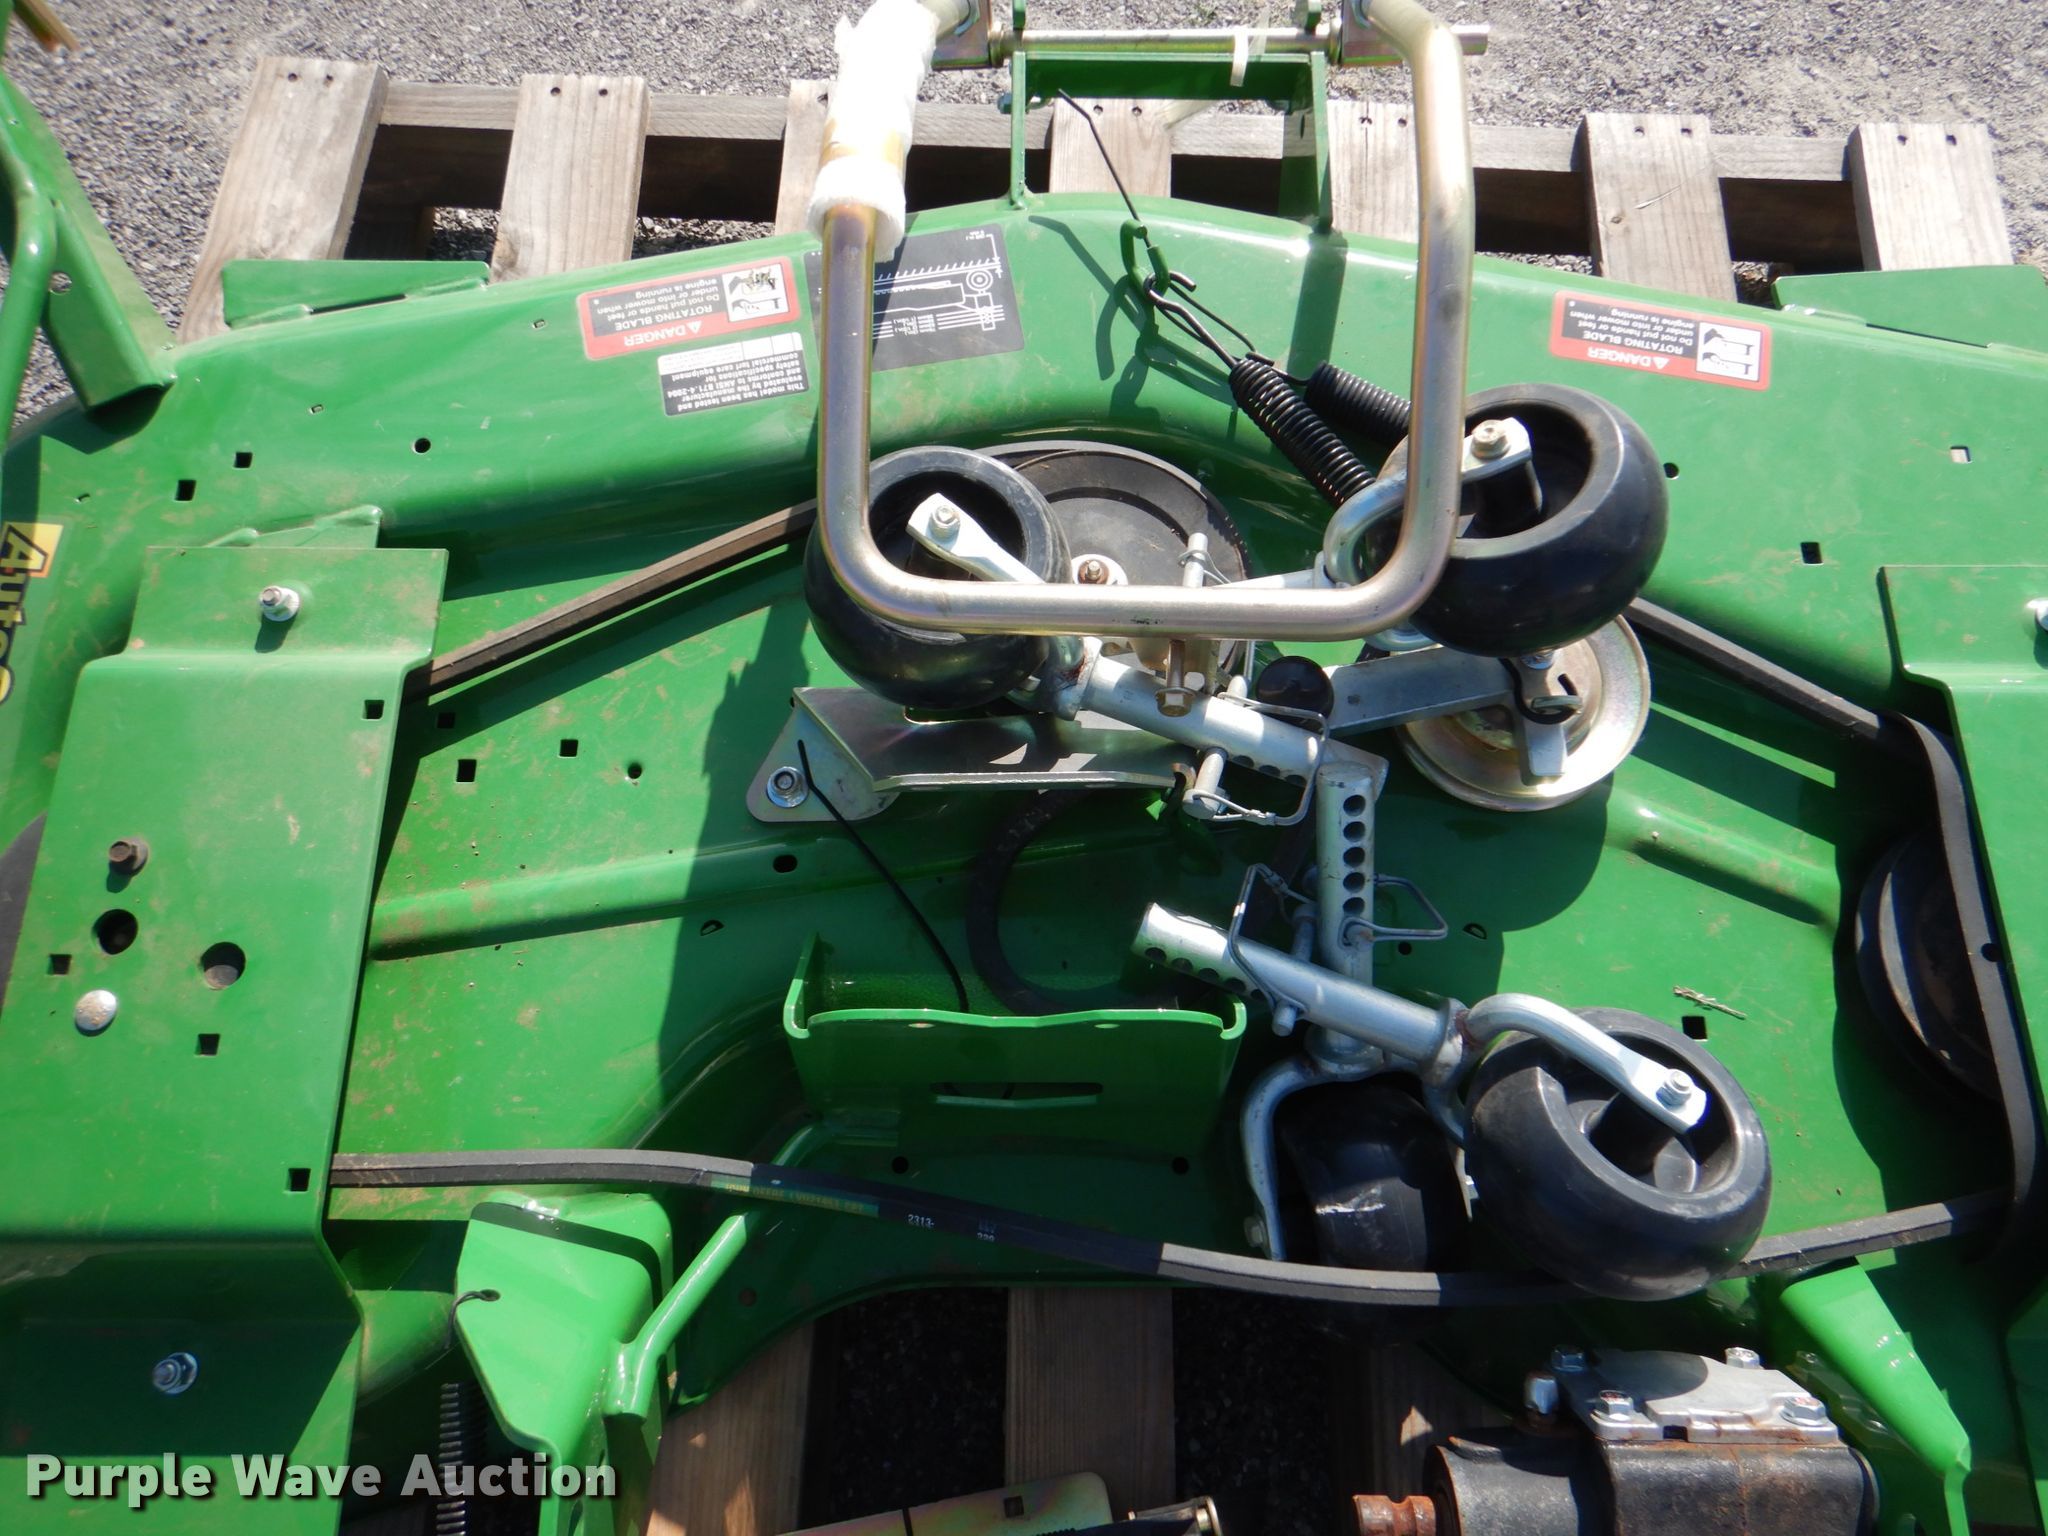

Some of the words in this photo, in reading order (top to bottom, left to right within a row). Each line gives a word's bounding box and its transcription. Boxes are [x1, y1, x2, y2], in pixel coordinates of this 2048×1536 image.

[684, 278, 717, 289] engine
[635, 287, 672, 299] running
[690, 286, 718, 296] under
[657, 293, 676, 302] into
[687, 296, 703, 305] not
[705, 293, 719, 301] Do
[624, 298, 655, 308] mower
[669, 298, 686, 308] put
[596, 304, 622, 314] when
[639, 303, 668, 314] hands
[654, 304, 712, 322] ROTATING
[607, 312, 625, 321] feet
[1569, 310, 1595, 320] when
[1610, 308, 1648, 321] running
[614, 315, 652, 330] BLADE
[1577, 320, 1596, 329] feet
[1597, 315, 1629, 325] mower
[1631, 320, 1650, 330] into
[1650, 316, 1659, 324] is
[1661, 318, 1694, 328] engine
[623, 324, 686, 346] DANGER
[1611, 325, 1640, 336] hands
[1642, 328, 1659, 338] put
[1665, 326, 1693, 336] under
[1583, 330, 1621, 344] BLADE
[1660, 333, 1677, 341] not
[1678, 337, 1692, 345] Do
[1623, 337, 1683, 354] ROTATING
[1587, 346, 1651, 366] DANGER
[759, 385, 785, 396] model
[786, 382, 804, 390] This
[720, 393, 741, 402] been
[742, 390, 757, 398] has
[677, 402, 692, 411] and
[694, 397, 719, 408] tested
